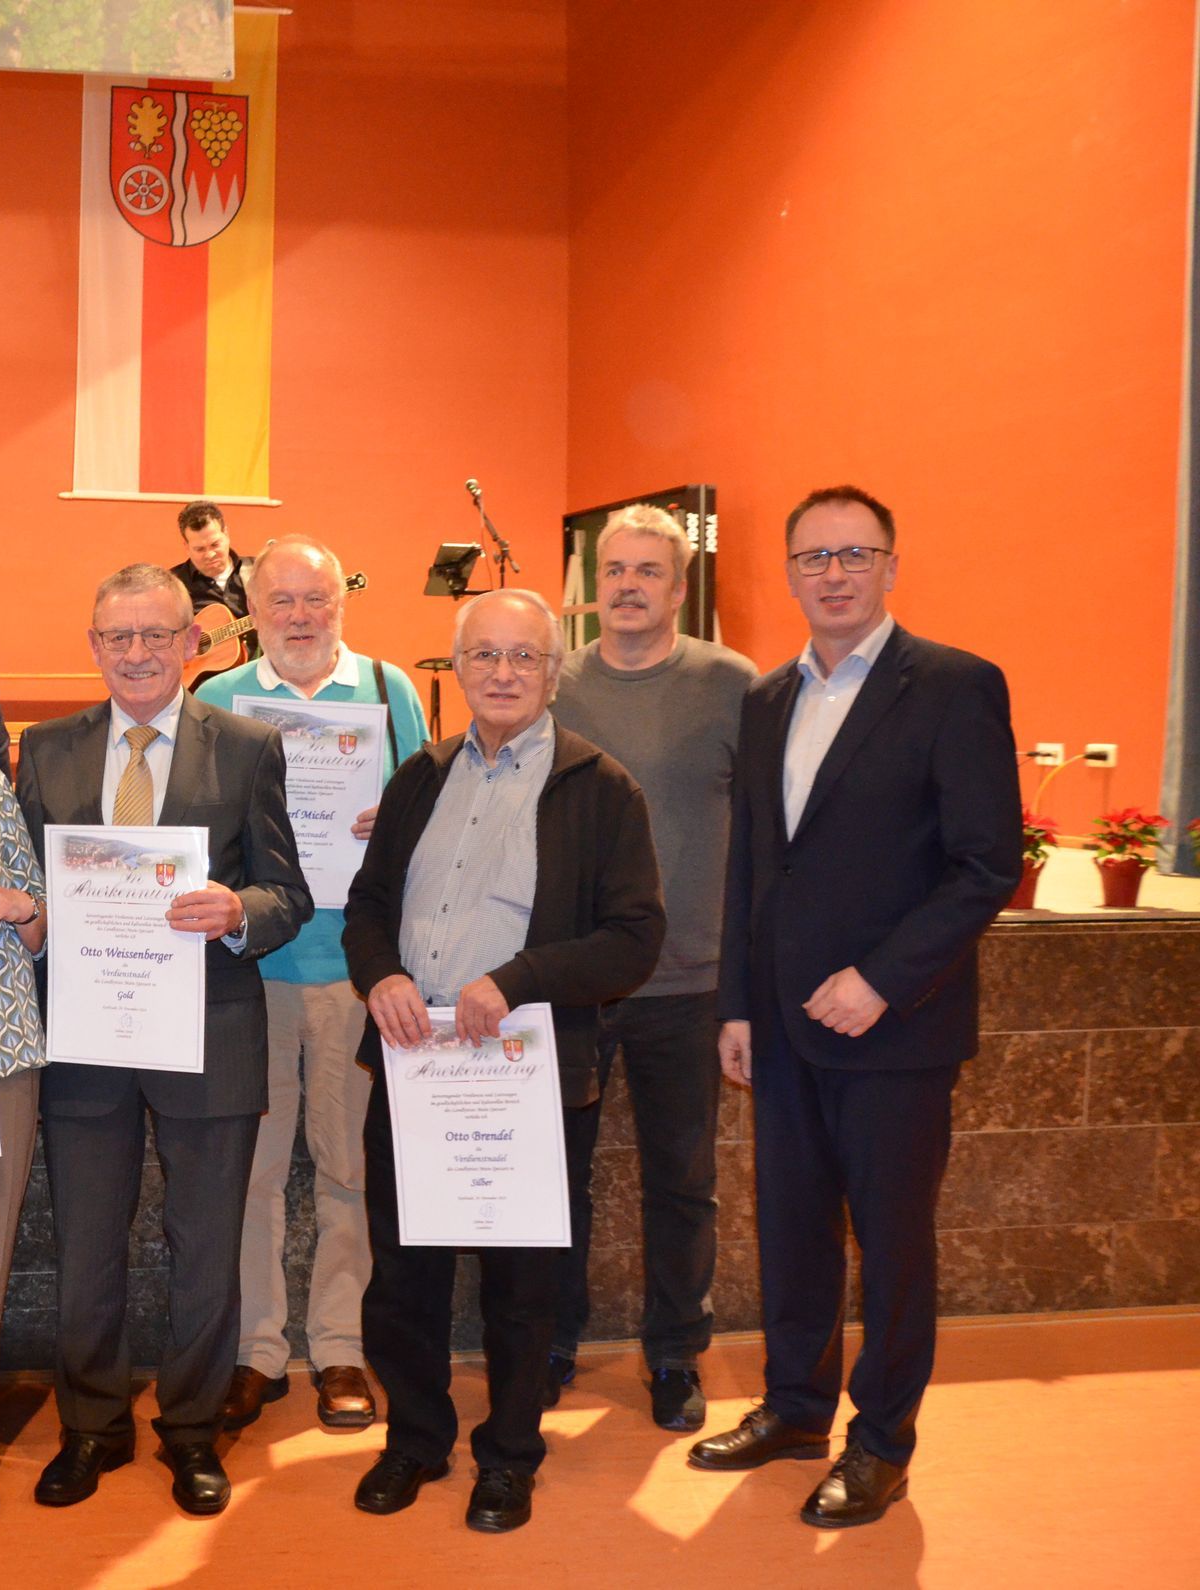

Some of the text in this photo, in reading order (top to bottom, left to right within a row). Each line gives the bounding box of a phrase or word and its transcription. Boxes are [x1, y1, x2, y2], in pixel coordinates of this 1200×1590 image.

[705, 513, 718, 553] JOOLA
[287, 809, 336, 821] arl Michel
[64, 878, 185, 901] Anerkennun
[80, 946, 174, 964] Otto Weissenberger
[117, 991, 134, 1001] Gold
[445, 1129, 514, 1142] Otto Brendel
